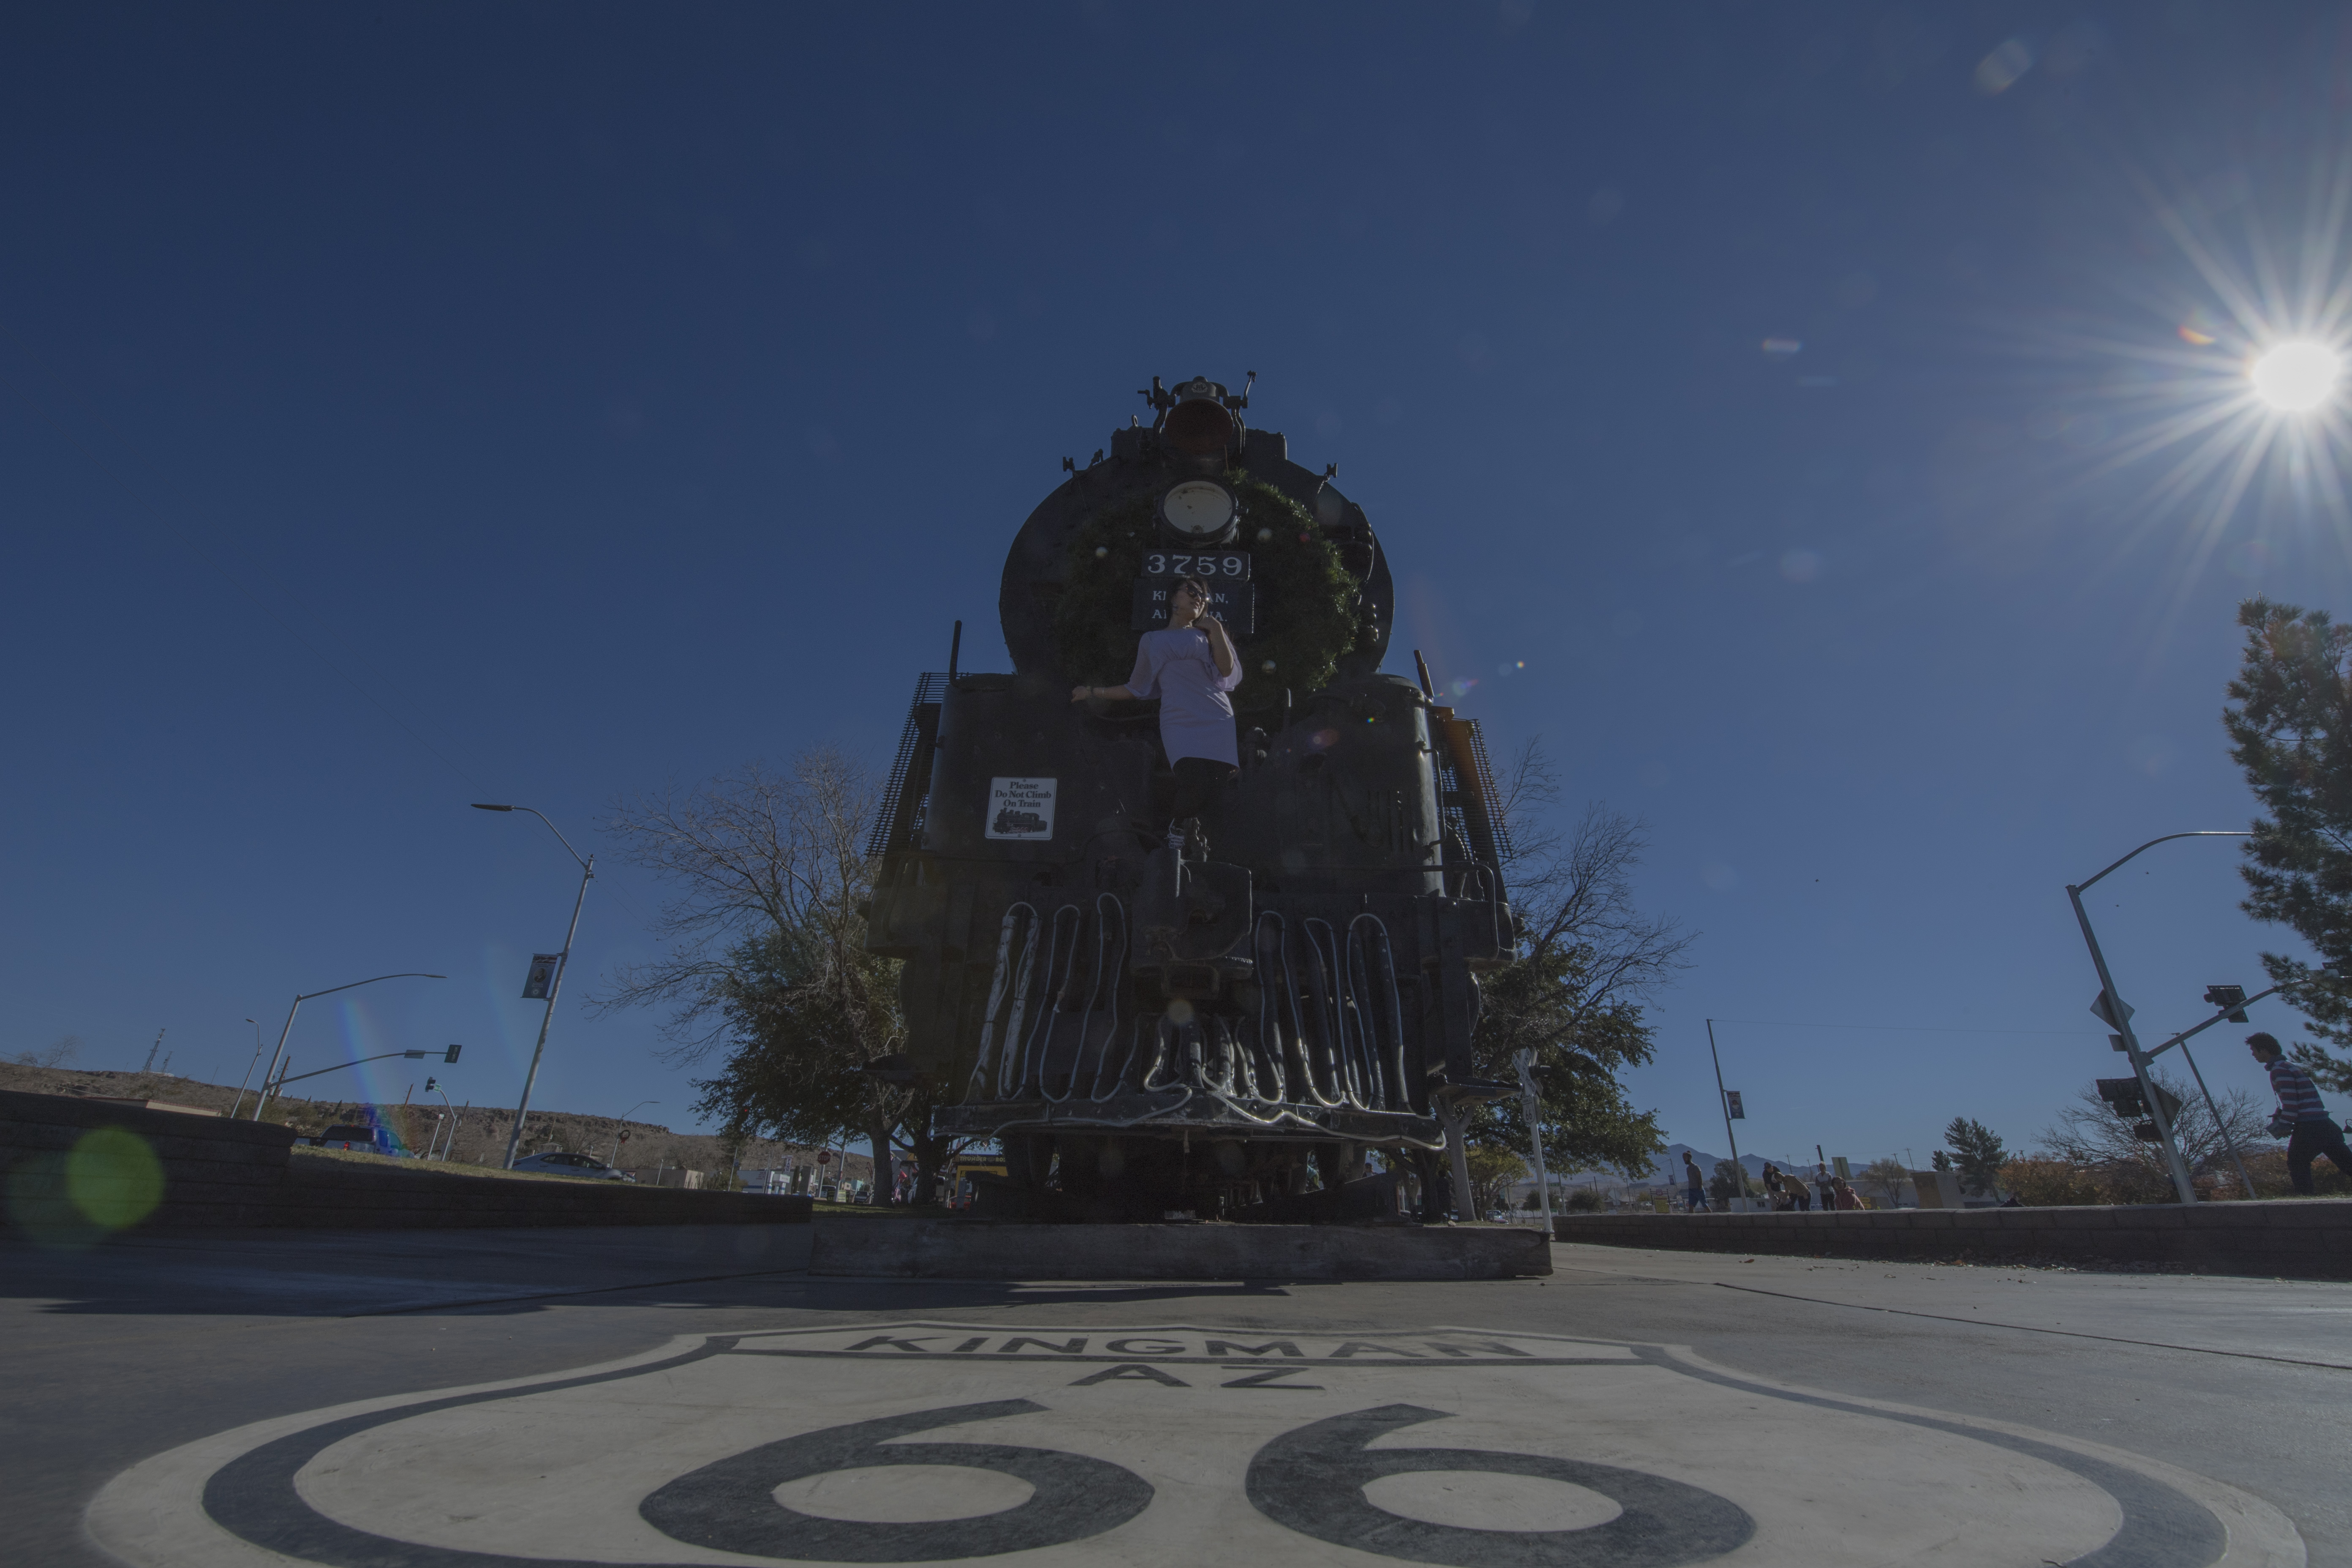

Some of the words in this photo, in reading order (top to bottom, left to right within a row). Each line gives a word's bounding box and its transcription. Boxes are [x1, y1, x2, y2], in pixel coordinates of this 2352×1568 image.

[1148, 554, 1242, 576] 3759
[1009, 781, 1039, 789] Please
[994, 790, 1007, 798] Do
[1009, 790, 1024, 798] Not
[1025, 791, 1051, 799] Climb
[1003, 799, 1016, 807] On
[1017, 799, 1041, 808] Train
[1525, 1075, 1535, 1092] ROAD
[1525, 1108, 1532, 1121] 66
[843, 1336, 1536, 1357] KINGMAN
[1066, 1364, 1326, 1391] AZ
[639, 1397, 1756, 1568] 66
